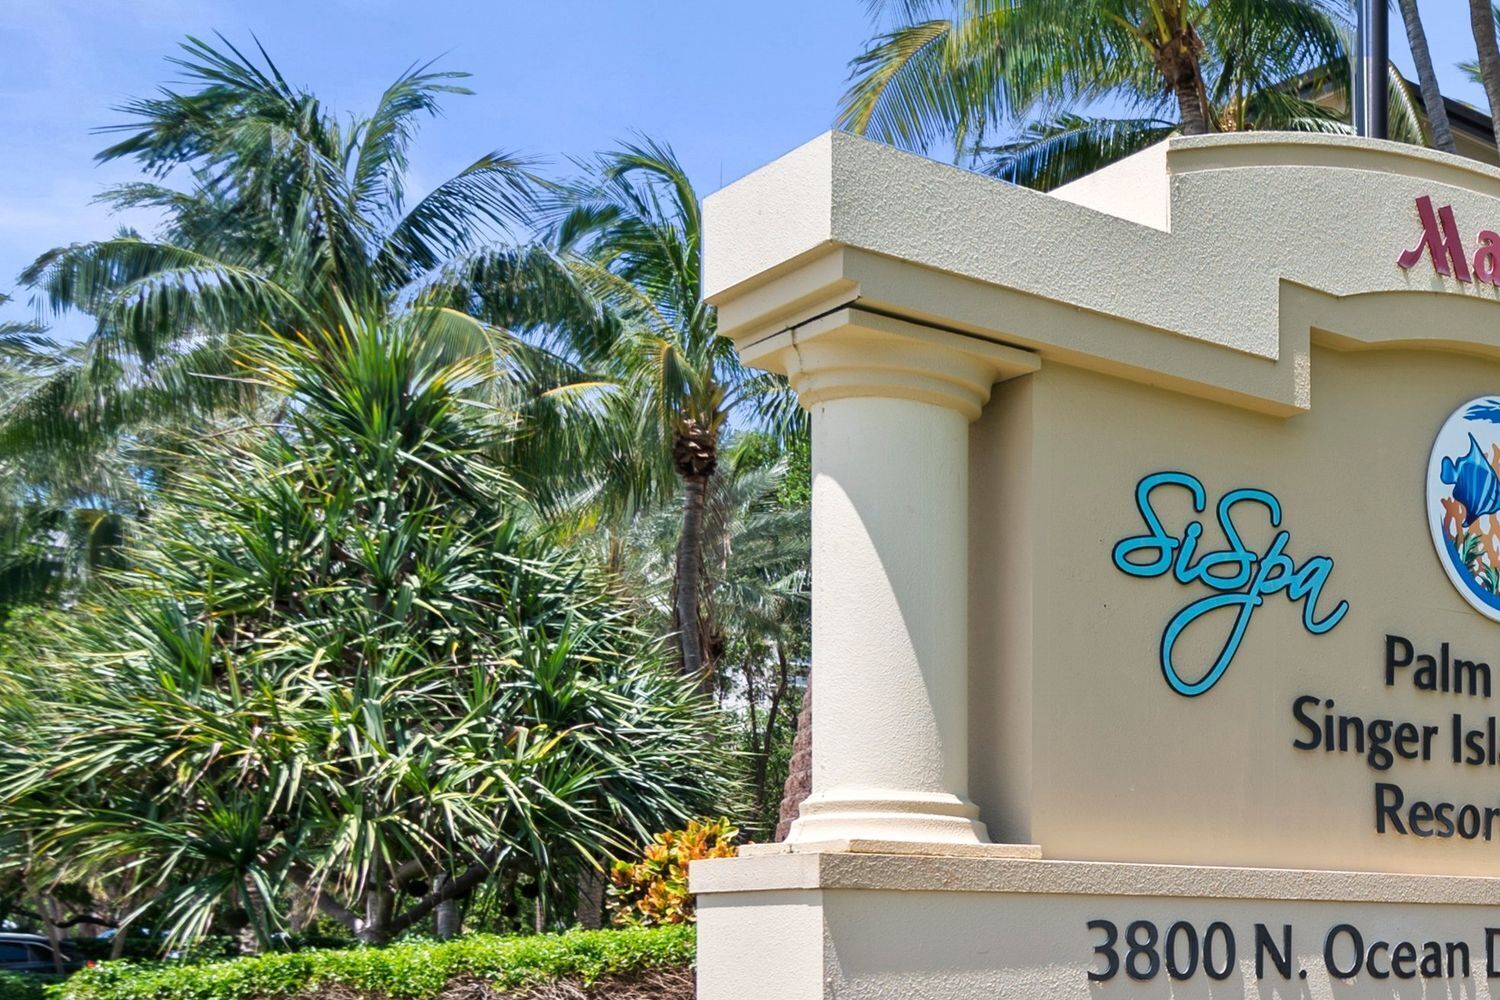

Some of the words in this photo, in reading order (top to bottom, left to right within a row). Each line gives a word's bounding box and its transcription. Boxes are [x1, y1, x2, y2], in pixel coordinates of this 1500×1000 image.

[1384, 633, 1493, 699] Palm
[1292, 694, 1438, 771] Singer
[1086, 919, 1236, 981] 3800
[1254, 922, 1309, 981] N.
[1322, 923, 1472, 980] Ocean
